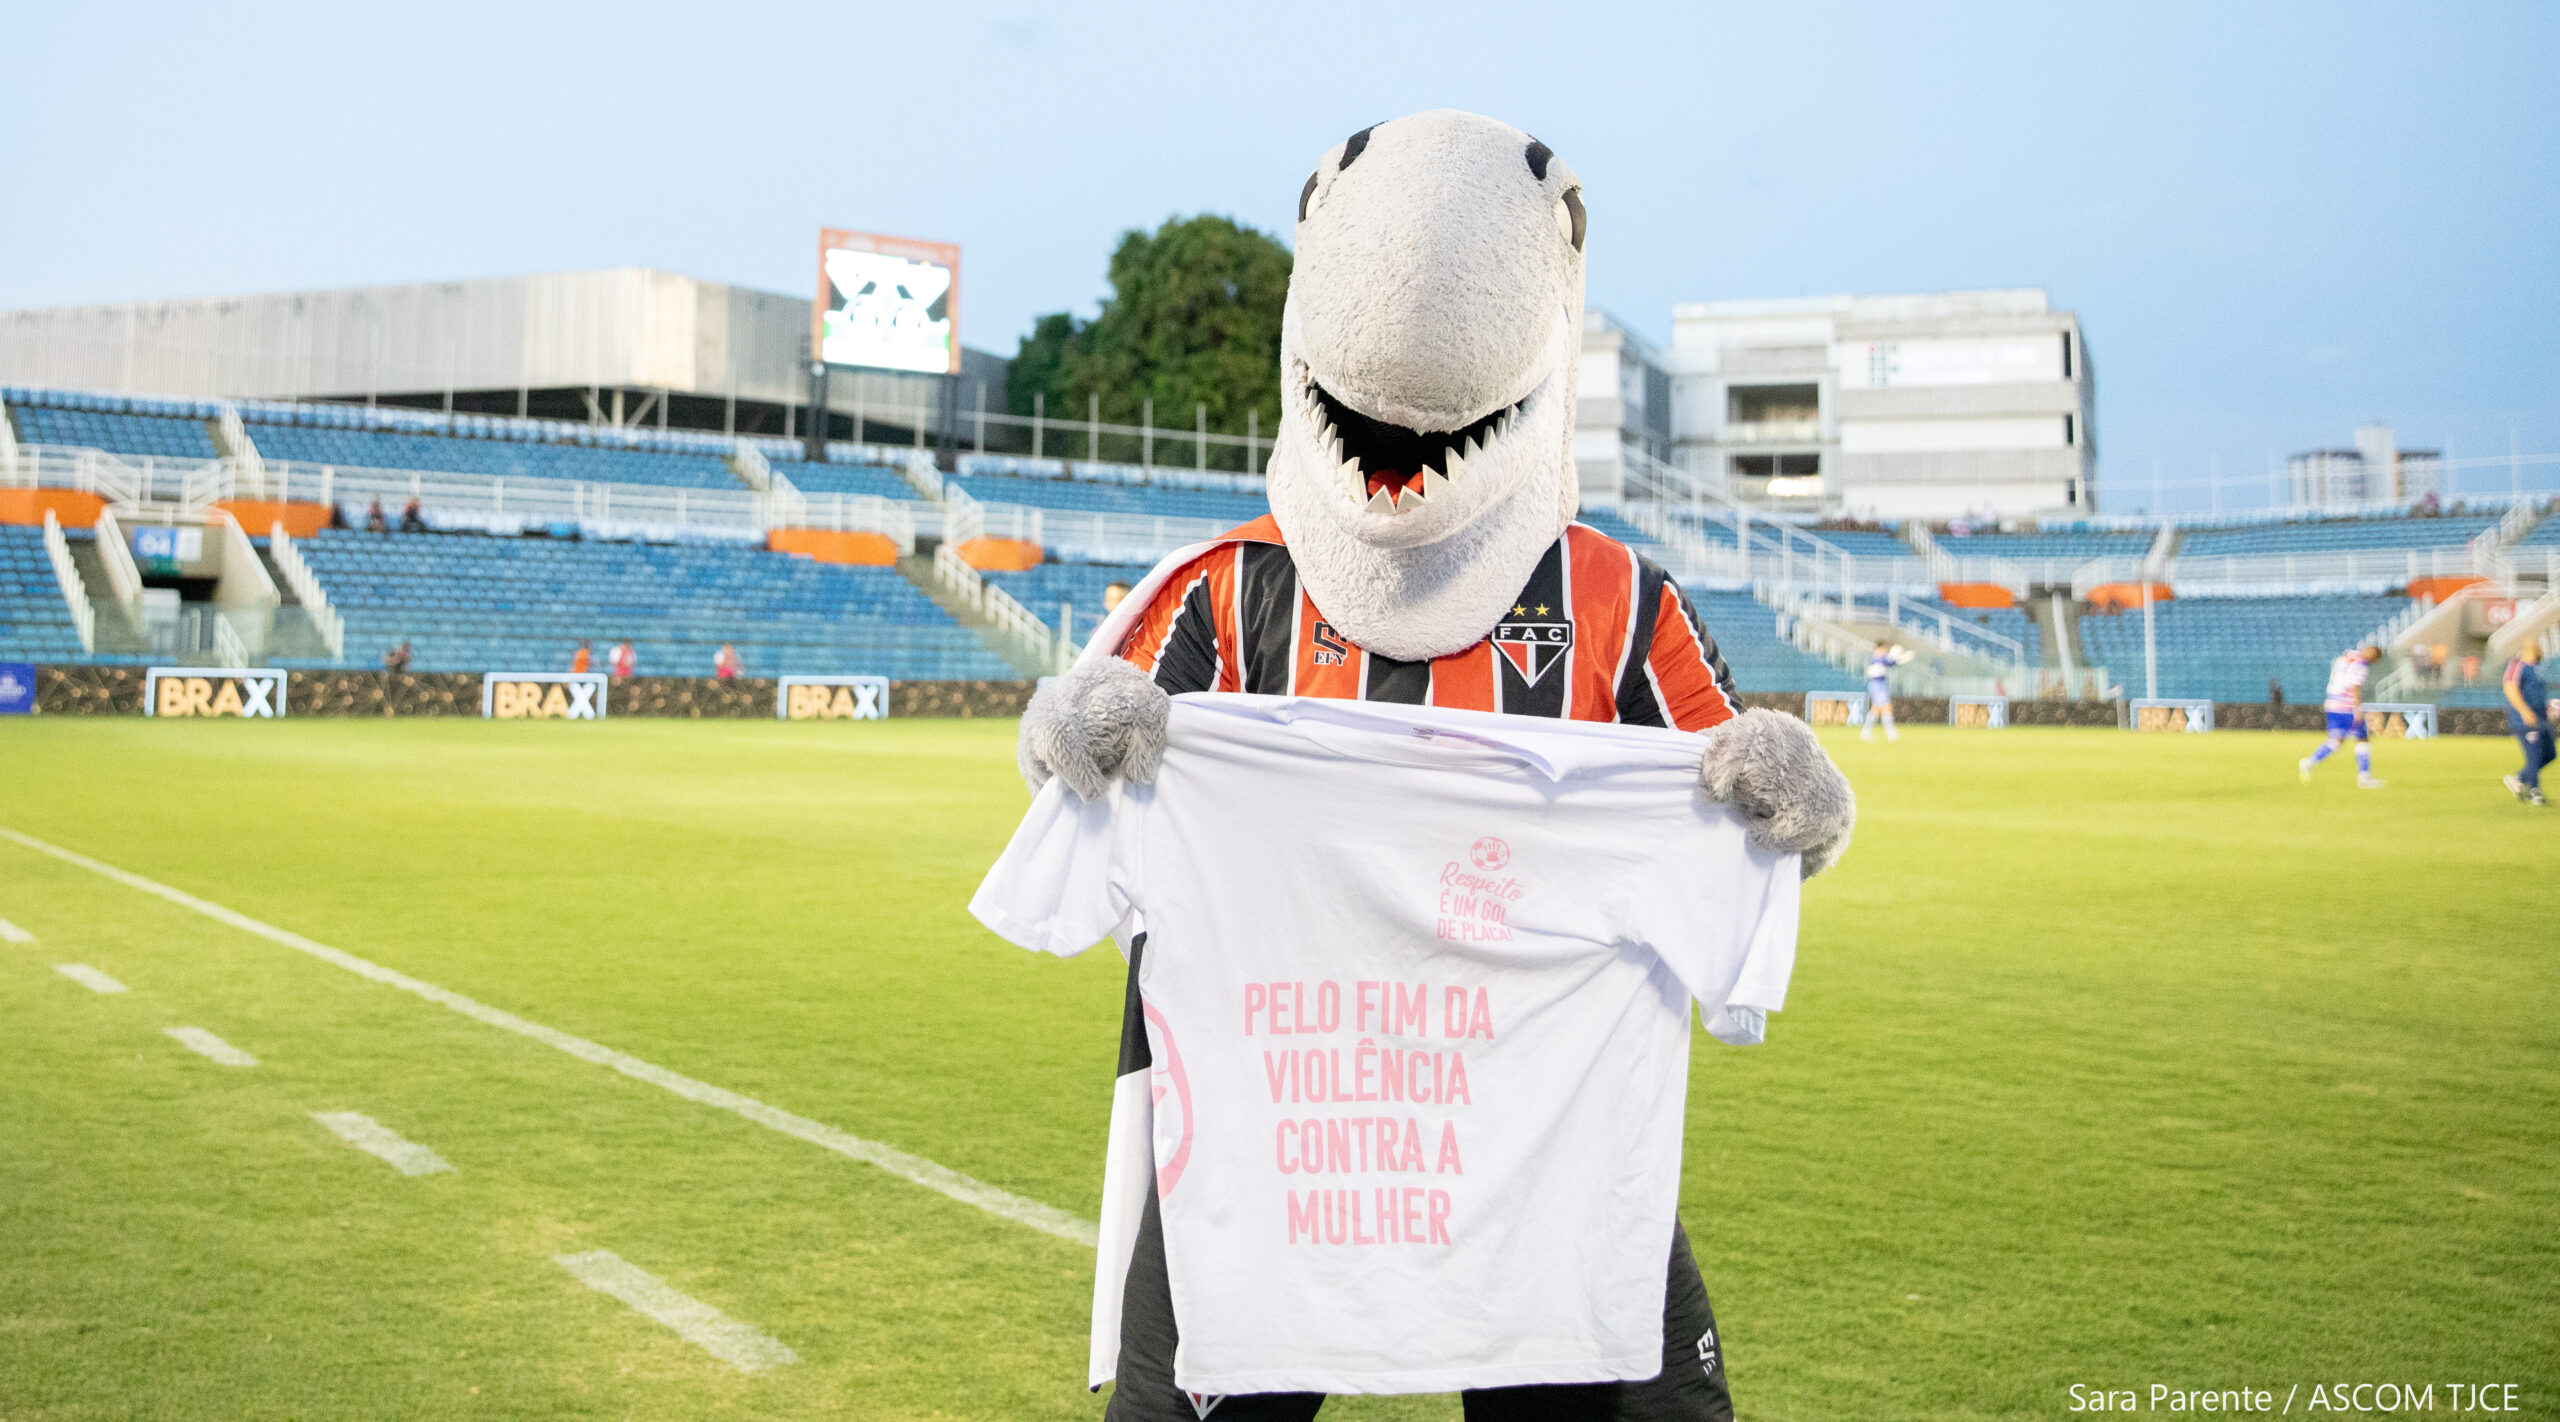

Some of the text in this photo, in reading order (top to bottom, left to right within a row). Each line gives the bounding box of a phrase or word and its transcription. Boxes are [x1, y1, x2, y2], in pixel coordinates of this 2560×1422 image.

[1500, 627, 1563, 641] FAC
[158, 677, 274, 717] BRAX
[494, 681, 596, 718] BRAX
[788, 684, 879, 720] BRAX
[2364, 711, 2428, 739] RAX
[1440, 861, 1524, 902] Respeito
[1440, 888, 1507, 925] É UM GOL
[1437, 918, 1457, 941] DE
[1245, 980, 1494, 1039] PELO FIM DA
[1263, 1037, 1472, 1105] VIOLÊNCIA
[1276, 1116, 1463, 1175] CONTRA A
[1287, 1187, 1452, 1246] MULHER
